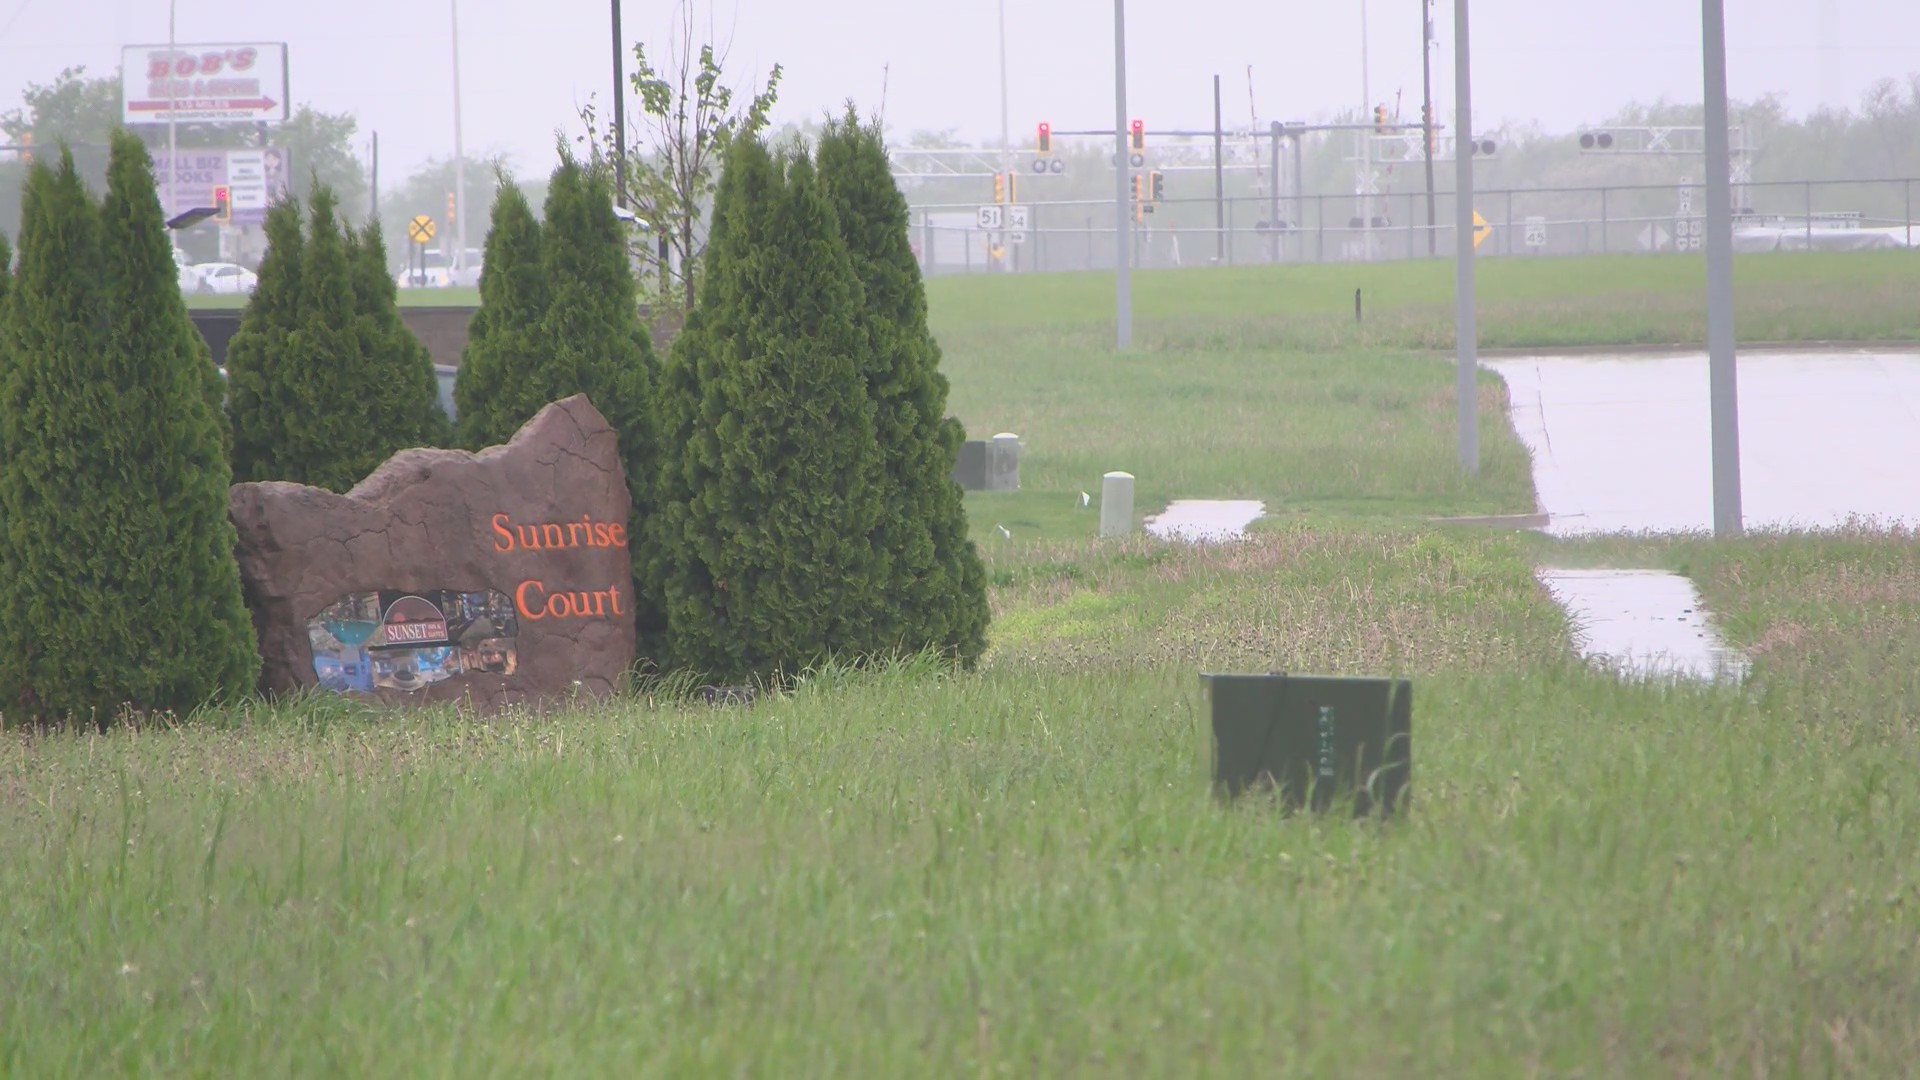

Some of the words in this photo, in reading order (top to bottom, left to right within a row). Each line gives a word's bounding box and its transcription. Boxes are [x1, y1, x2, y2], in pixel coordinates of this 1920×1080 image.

[148, 48, 257, 78] BOB'S
[196, 99, 230, 108] MILES
[154, 111, 253, 119] BOSIMPORTS.COM
[197, 156, 222, 169] BIZ
[982, 210, 997, 224] 51
[492, 512, 627, 552] Sunrise
[515, 580, 625, 620] Court
[387, 623, 427, 641] SUNSET
